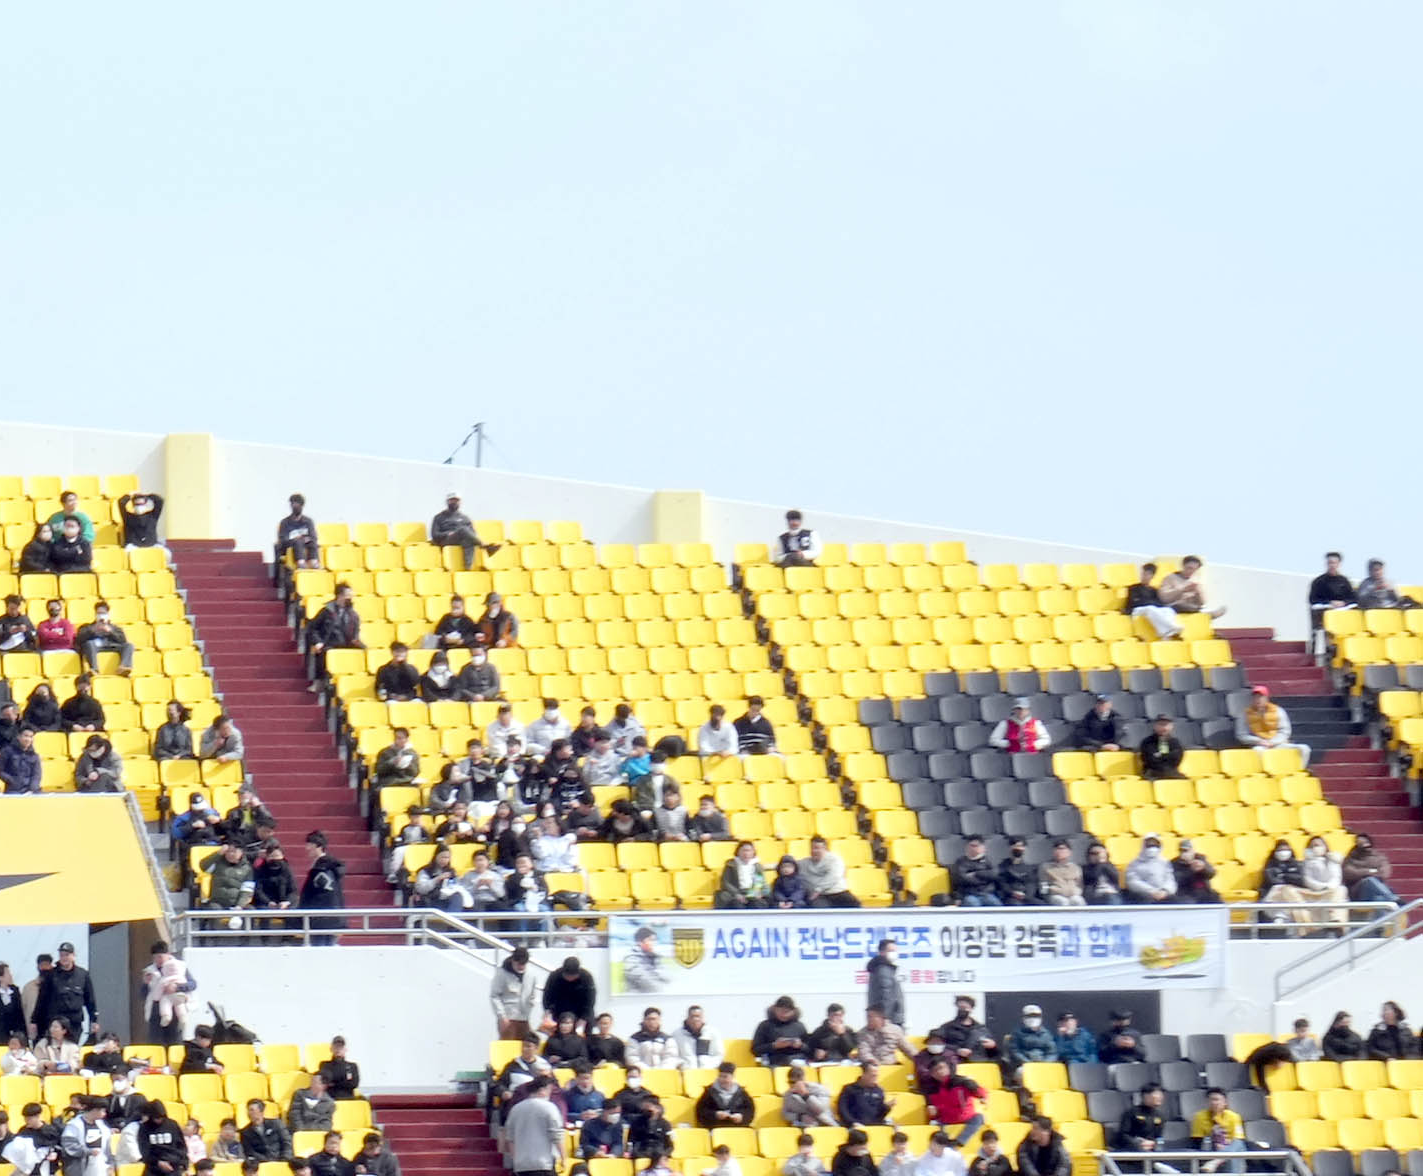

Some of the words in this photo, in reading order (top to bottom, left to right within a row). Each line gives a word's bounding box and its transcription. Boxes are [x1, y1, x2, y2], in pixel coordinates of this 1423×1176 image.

[713, 927, 790, 959] AGAIN
[940, 925, 1006, 959] 이장관
[1015, 925, 1081, 959] 감독과
